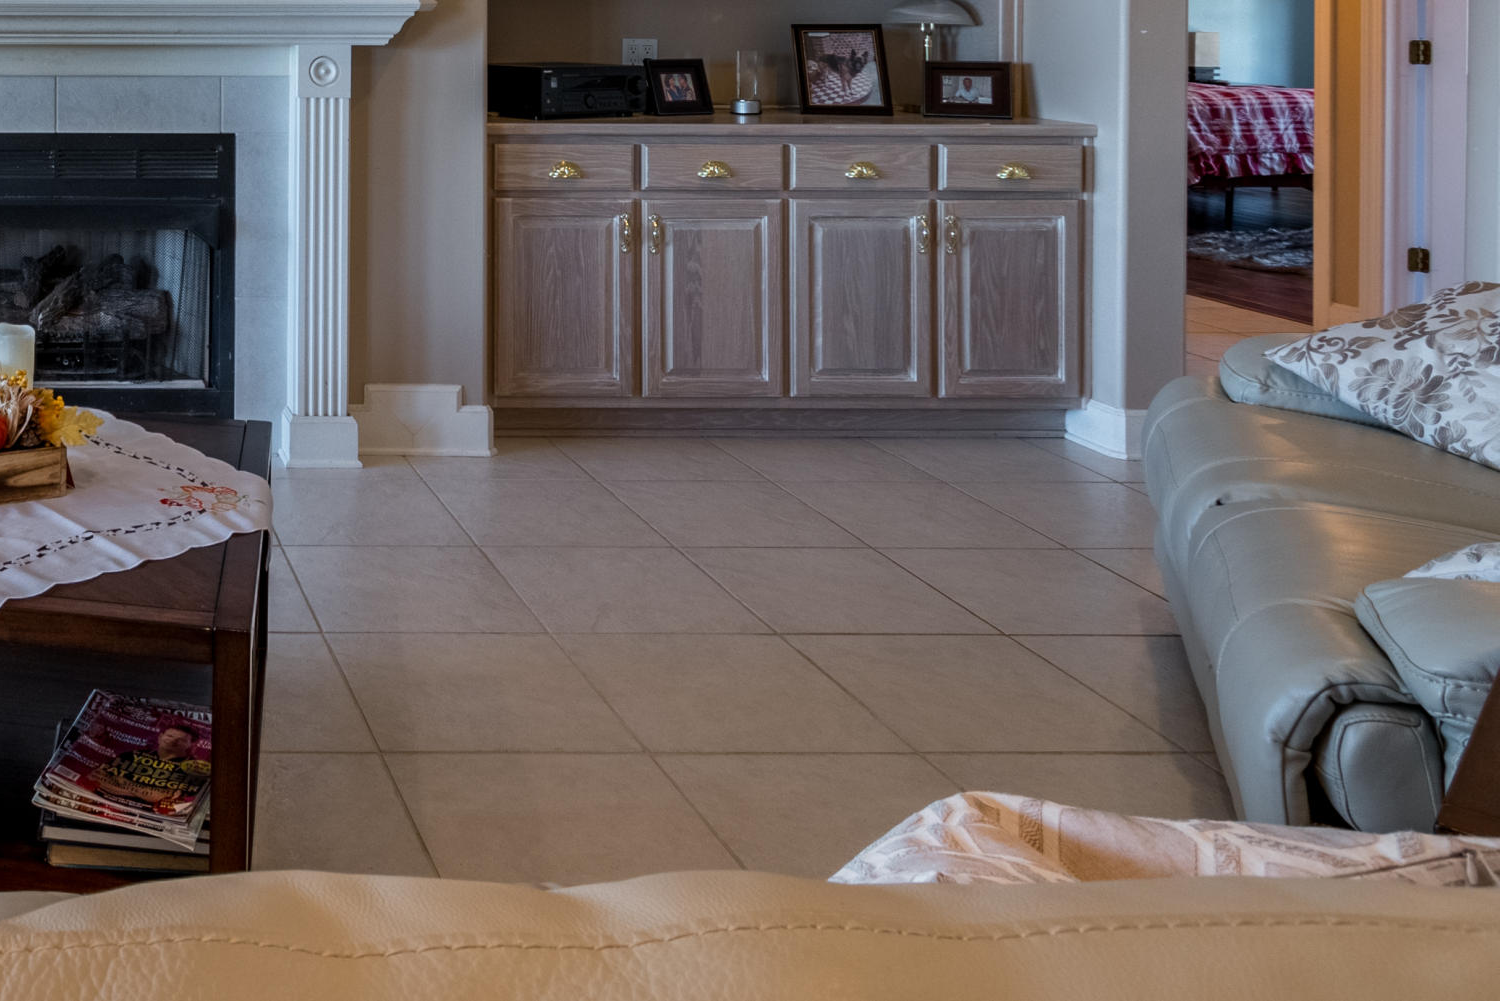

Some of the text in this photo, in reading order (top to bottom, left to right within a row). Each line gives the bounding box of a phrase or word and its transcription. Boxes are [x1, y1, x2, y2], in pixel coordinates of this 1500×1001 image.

[133, 754, 175, 772] YOUR
[99, 763, 127, 777] FAT
[132, 773, 200, 793] TRIGGER
